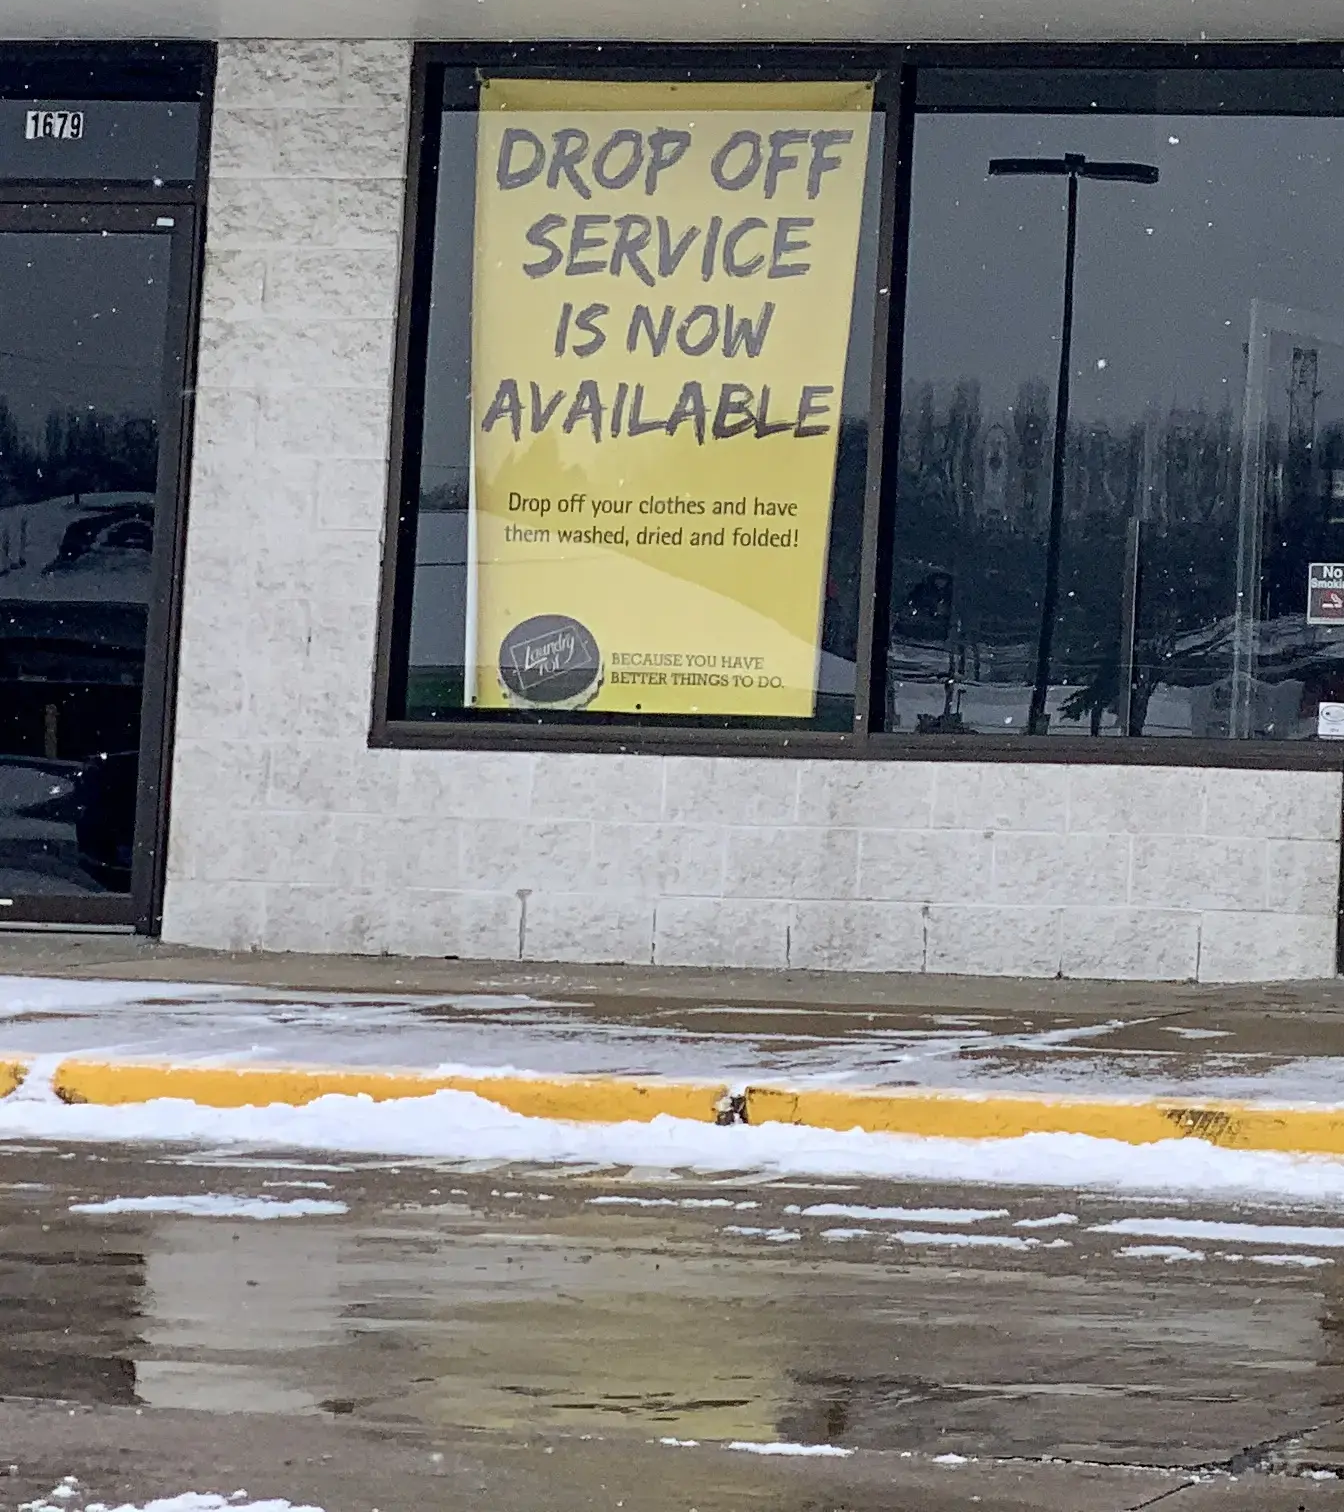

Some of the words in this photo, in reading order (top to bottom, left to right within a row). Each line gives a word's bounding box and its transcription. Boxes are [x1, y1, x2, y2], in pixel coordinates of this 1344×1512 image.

[31, 112, 81, 138] 1679
[496, 126, 692, 200] DROP
[710, 129, 854, 200] OFF
[522, 213, 815, 287] SERVICE
[554, 301, 610, 358] IS
[626, 301, 775, 358] NOW
[481, 378, 834, 445] AVAILABLE
[508, 492, 551, 517] Drop
[557, 494, 587, 513] off
[591, 497, 633, 518] your
[638, 495, 705, 515] clothes
[712, 497, 746, 516] and
[753, 497, 798, 517] have
[504, 524, 550, 544] them
[557, 525, 630, 546] washed,
[636, 526, 683, 546] dried
[690, 528, 725, 547] and
[732, 527, 799, 548] folded!
[1322, 565, 1343, 578] No
[525, 633, 575, 671] Laundry
[611, 652, 683, 667] BECAUSE
[685, 654, 717, 668] YOU
[721, 655, 764, 670] HAVE
[610, 671, 667, 685] BETTER
[670, 672, 729, 687] THINGS
[732, 675, 754, 688] TO
[757, 676, 785, 689] DO.
